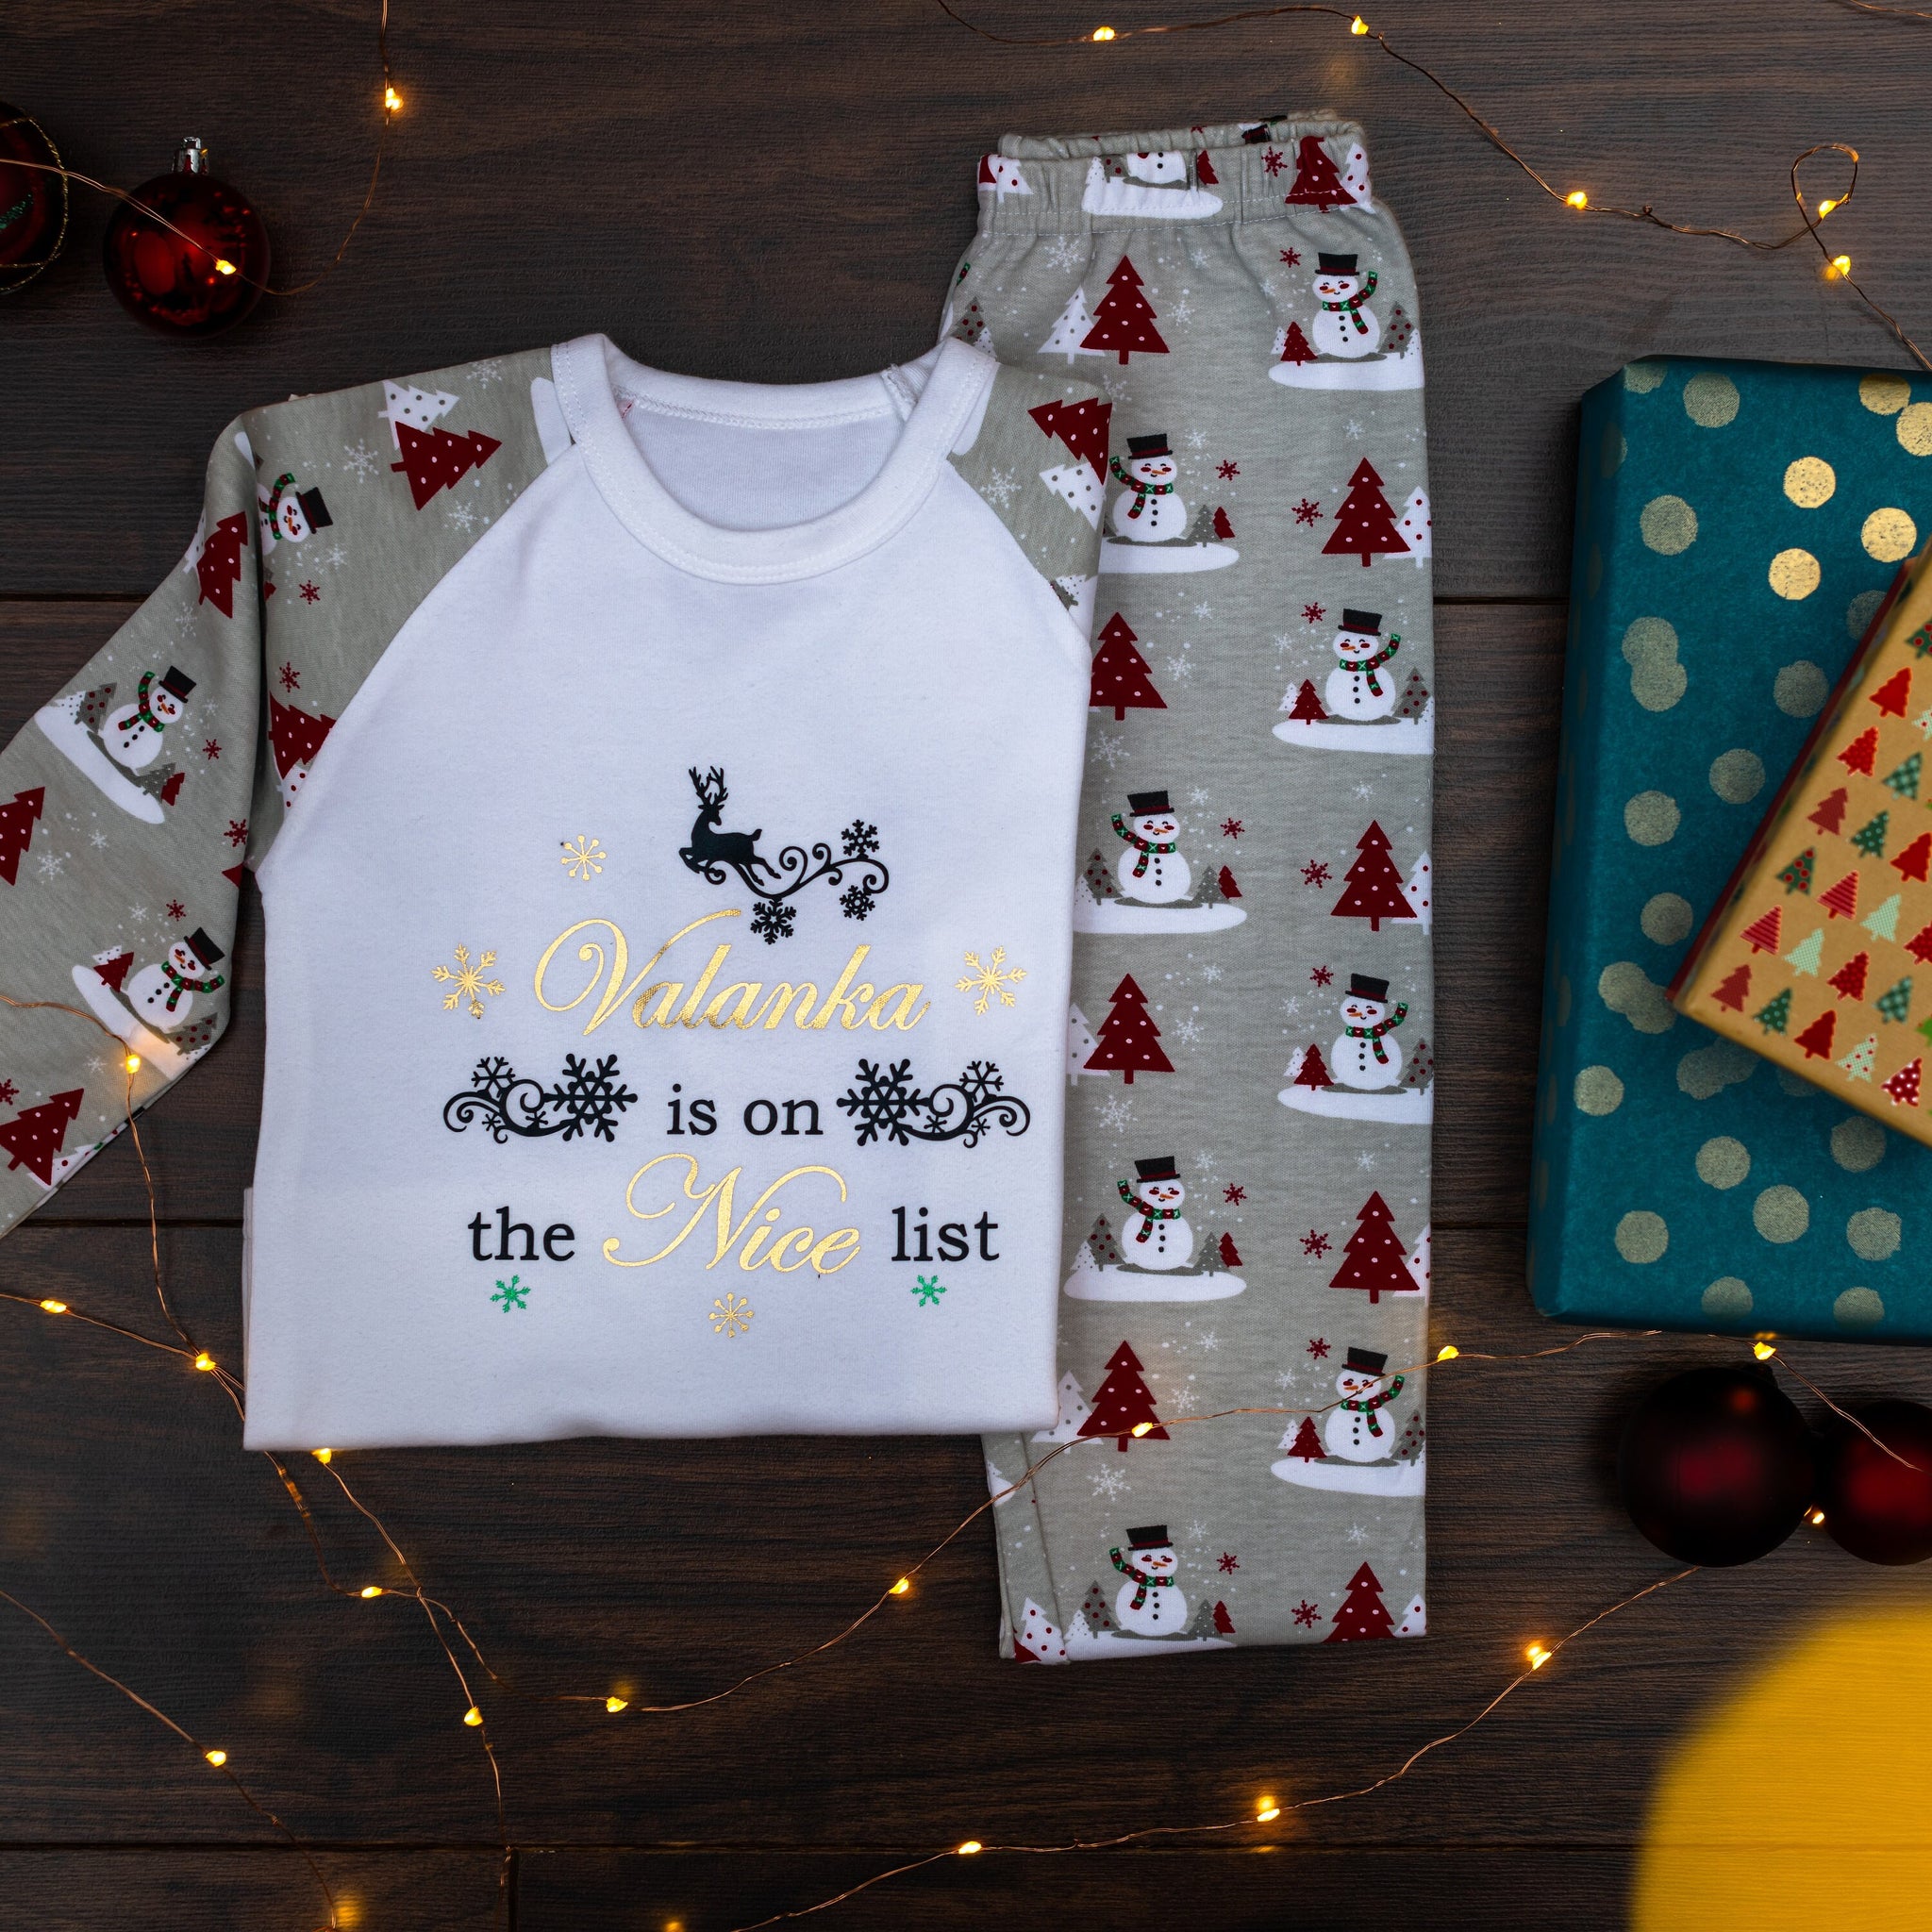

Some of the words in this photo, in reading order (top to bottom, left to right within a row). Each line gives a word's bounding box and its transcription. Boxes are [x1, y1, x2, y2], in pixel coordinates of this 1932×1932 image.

[534, 908, 930, 1037] Valanka
[666, 1083, 719, 1136] is
[743, 1097, 824, 1136] on
[468, 1206, 576, 1262] the
[602, 1153, 861, 1274] Nice
[891, 1206, 1000, 1262] list
